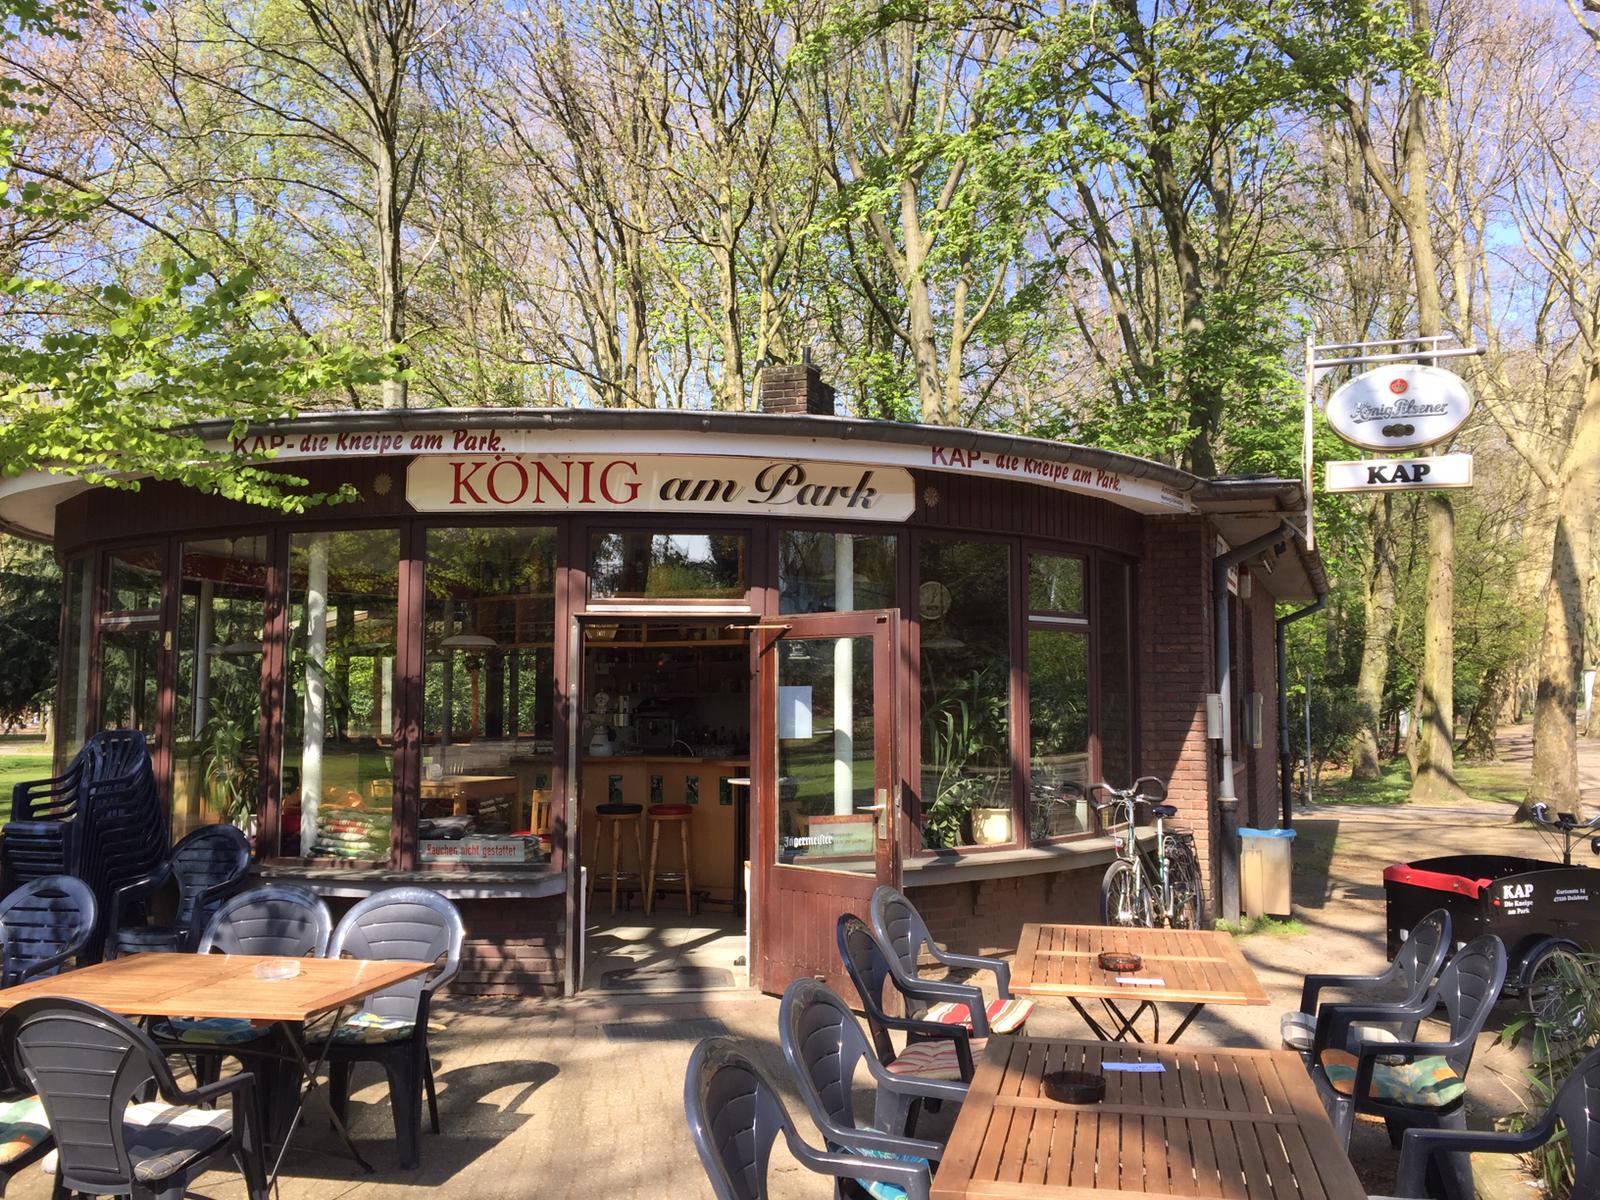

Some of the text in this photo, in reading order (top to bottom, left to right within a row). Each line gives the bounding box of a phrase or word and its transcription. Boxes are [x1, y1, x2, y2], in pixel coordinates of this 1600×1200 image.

[335, 431, 403, 454] Kneipe
[410, 434, 442, 450] am
[452, 429, 506, 452] Park.
[449, 454, 882, 509] KÖNIG am Park
[1023, 459, 1069, 482] Kneipe
[1072, 468, 1092, 484] am
[1366, 463, 1431, 484] KAP
[482, 845, 516, 858] gestattet
[1503, 883, 1534, 899] KAP
